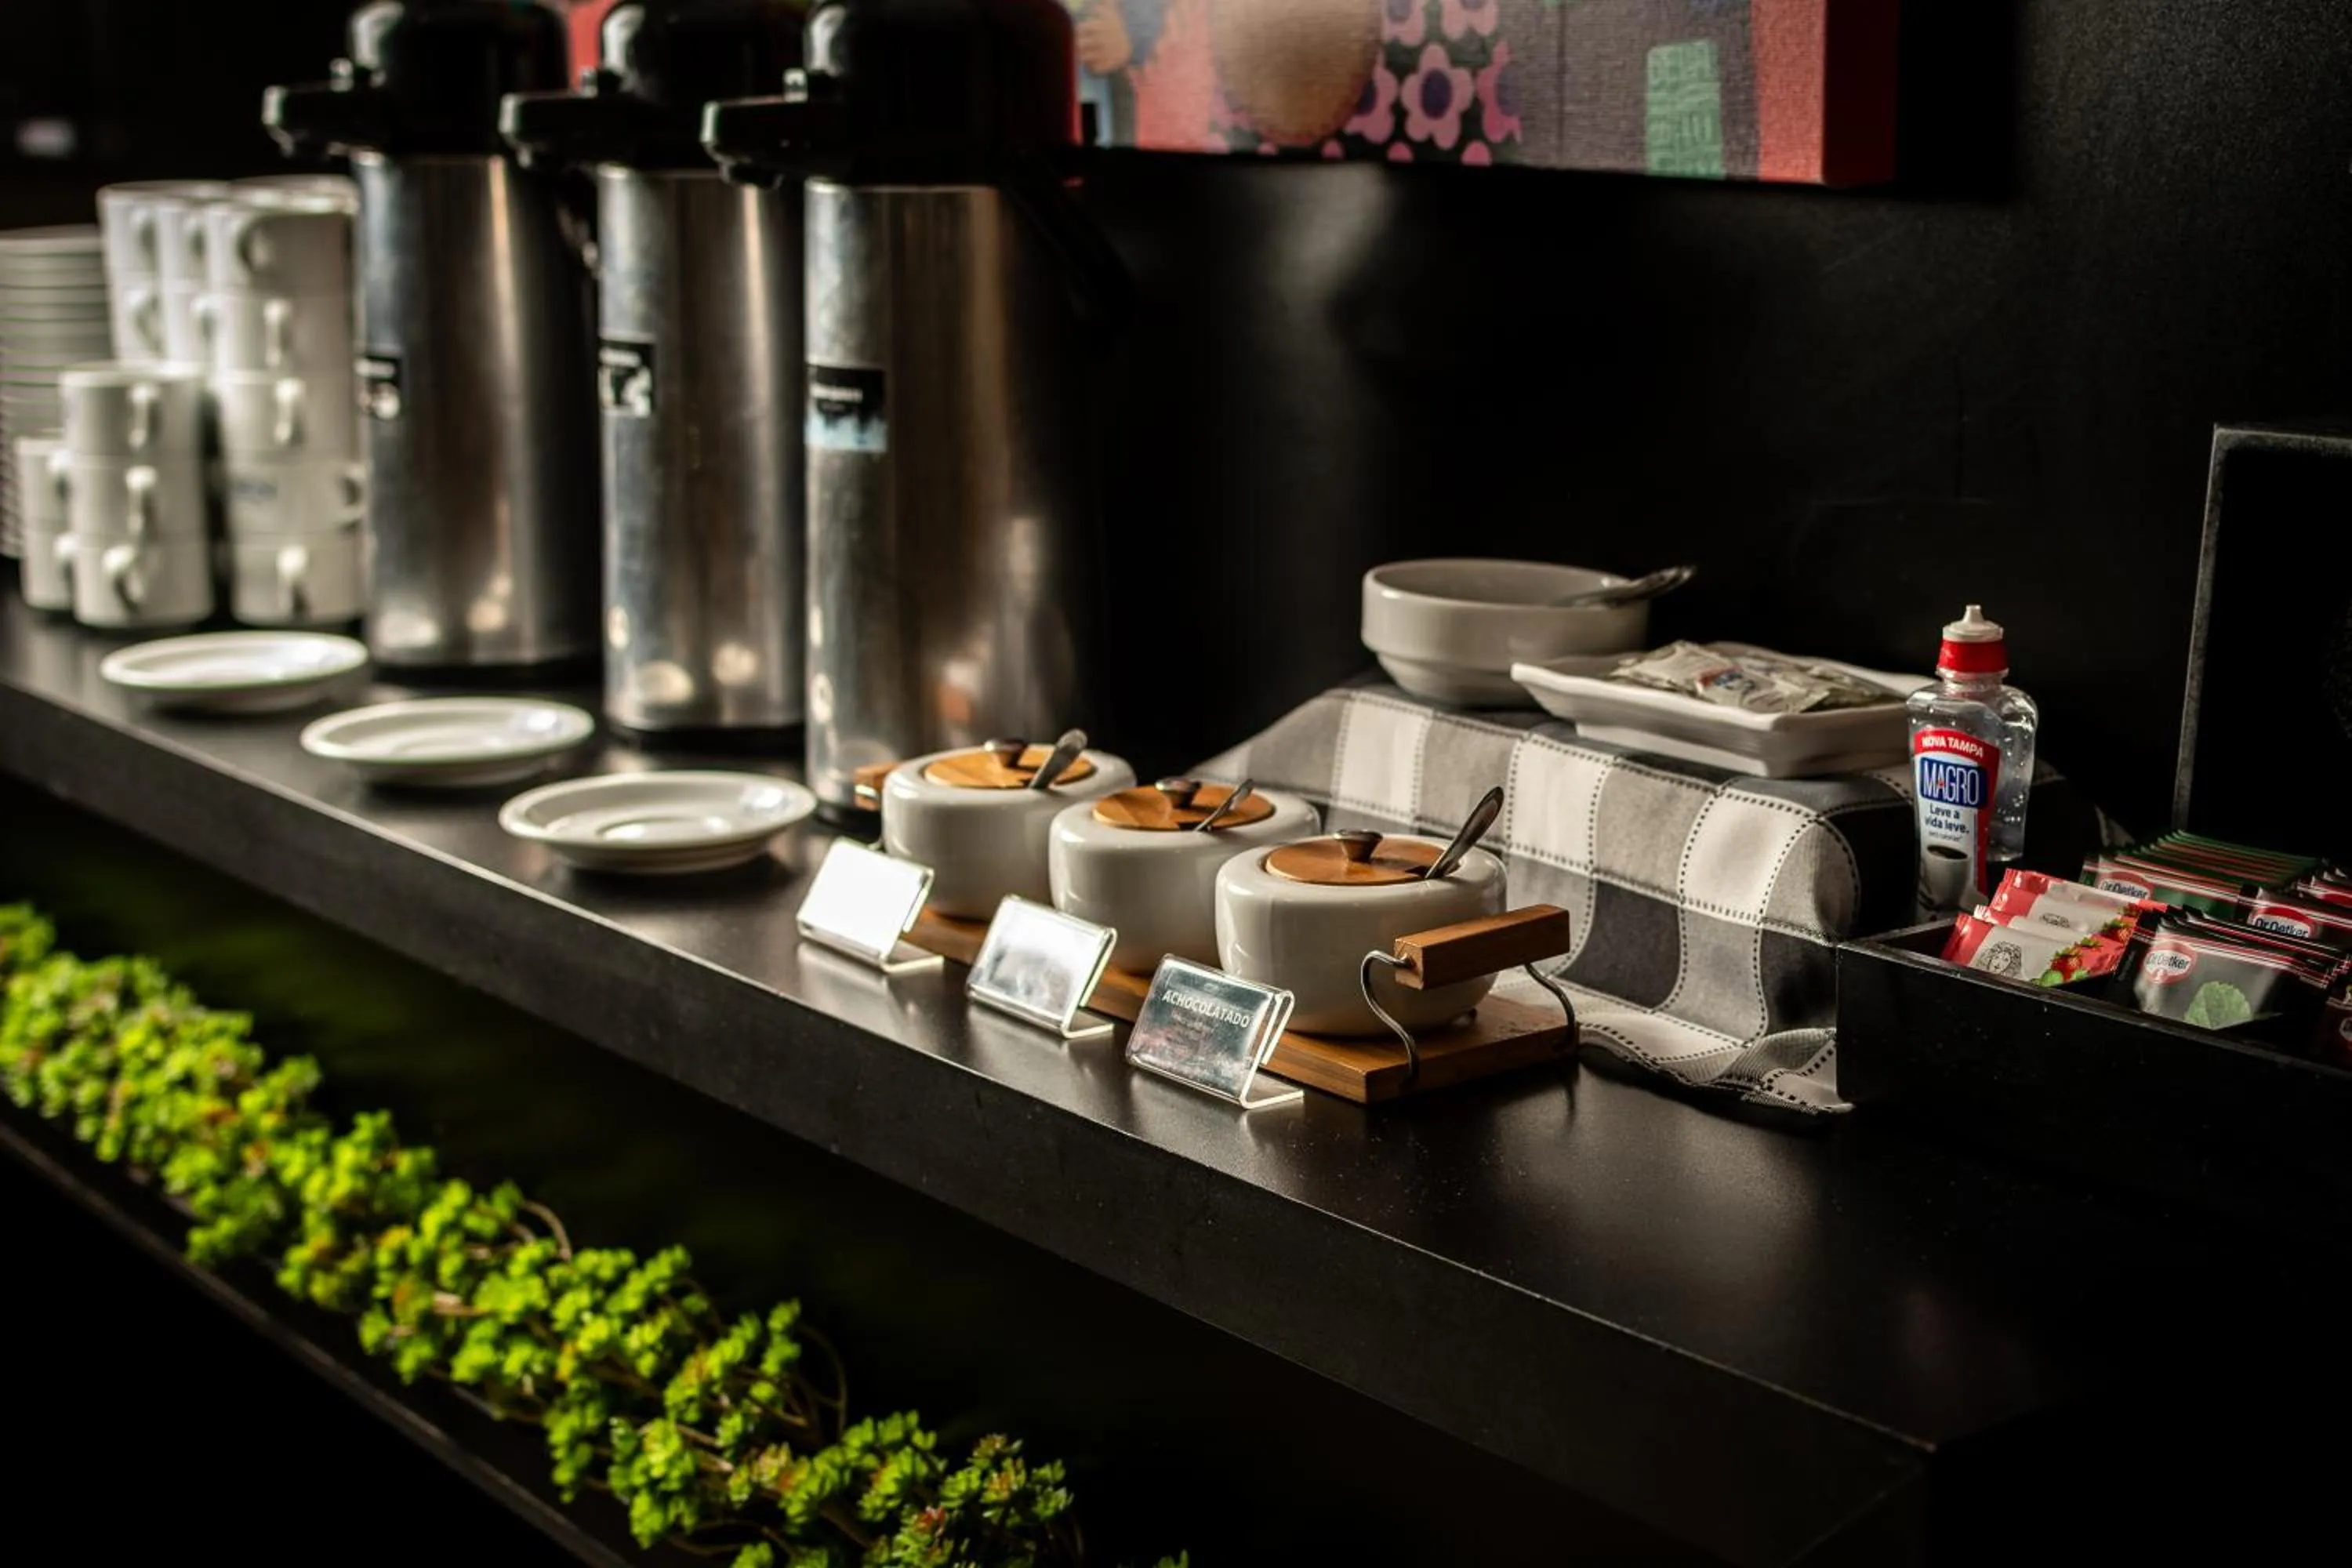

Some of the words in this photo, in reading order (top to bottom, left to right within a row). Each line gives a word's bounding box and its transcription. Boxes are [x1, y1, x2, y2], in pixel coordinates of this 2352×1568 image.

[1922, 736, 1947, 748] NOVA
[1947, 736, 1984, 758] TAMPA
[1923, 760, 1980, 805] MAGRO
[1925, 815, 1944, 829] vida
[1929, 804, 1951, 818] Leve
[1953, 810, 1960, 819] a
[1162, 989, 1250, 1028] ACHOCOLATADO
